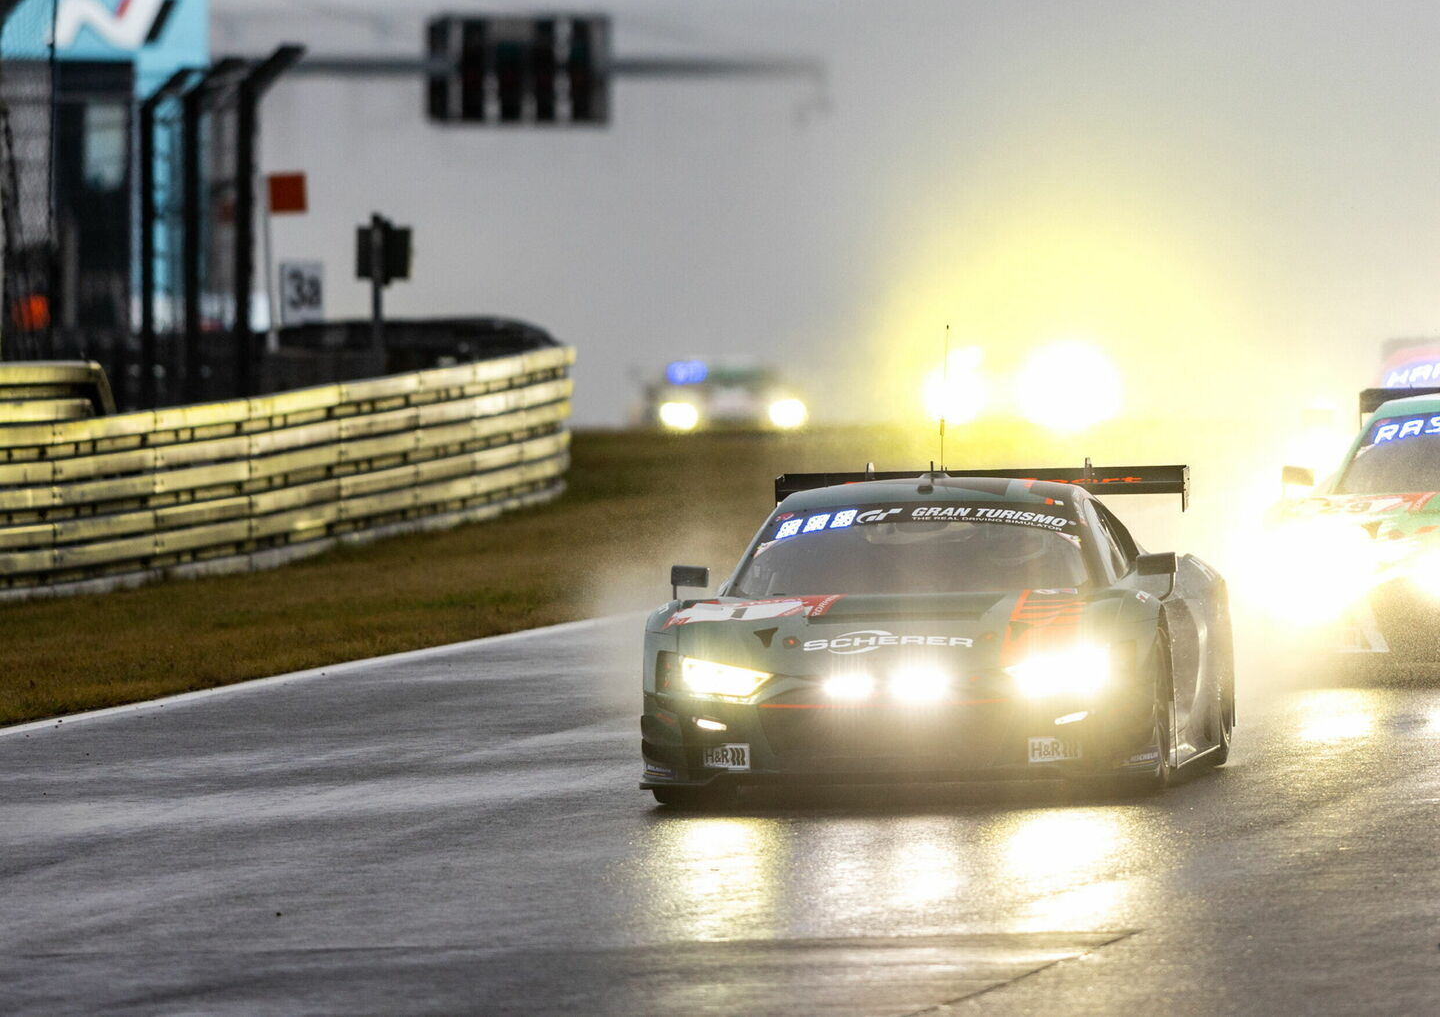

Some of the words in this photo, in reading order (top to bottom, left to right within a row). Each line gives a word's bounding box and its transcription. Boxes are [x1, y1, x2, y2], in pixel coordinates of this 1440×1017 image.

[287, 269, 322, 310] 3a
[911, 507, 971, 517] GRAN
[1004, 520, 1062, 531] SIMULATOR
[803, 635, 974, 652] SCHERER
